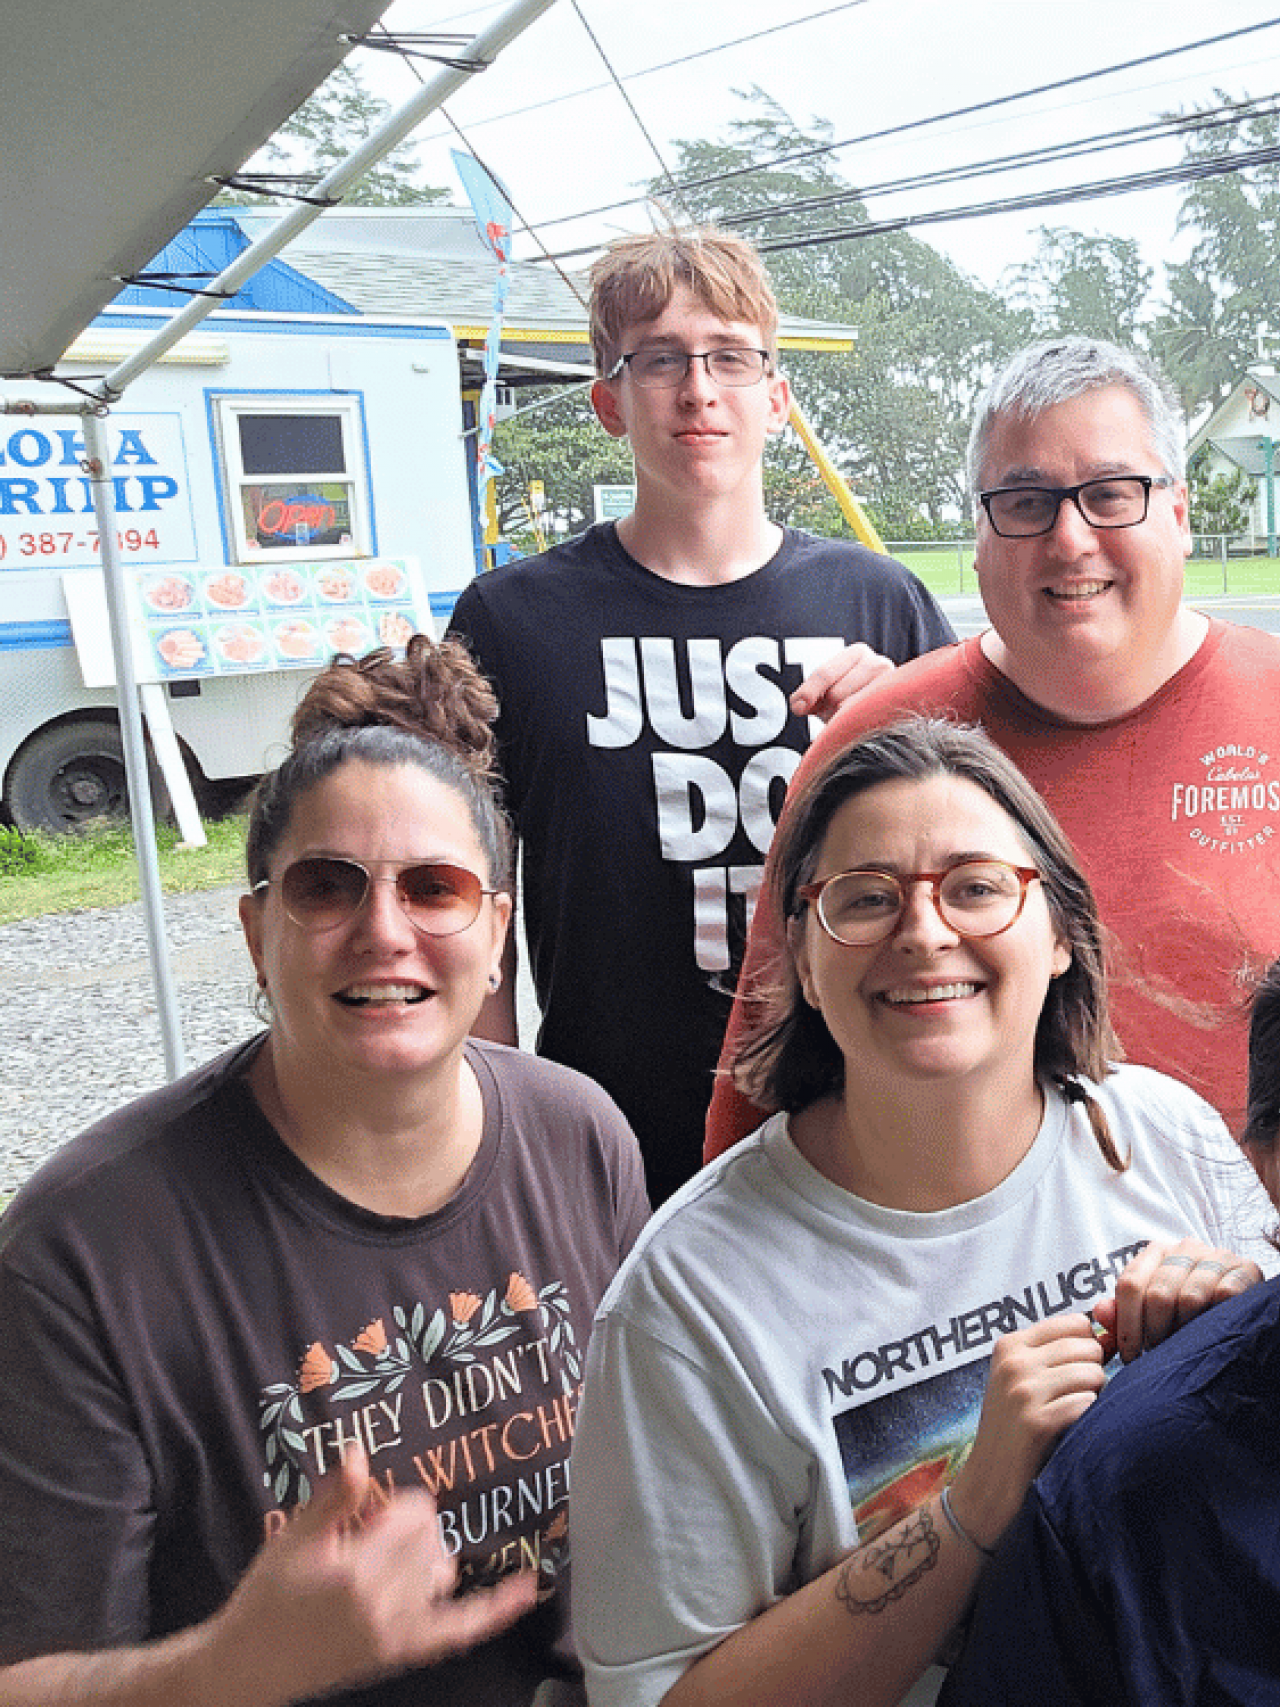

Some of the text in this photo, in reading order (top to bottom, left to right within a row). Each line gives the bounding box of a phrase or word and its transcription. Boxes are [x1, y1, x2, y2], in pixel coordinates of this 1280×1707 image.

[0, 428, 159, 468] OHA
[586, 636, 846, 749] JUST
[650, 746, 802, 861] DO
[821, 1283, 1039, 1405] NORTHERN
[303, 1337, 549, 1476] THEY DIDN'T
[438, 1459, 571, 1557] BURNE
